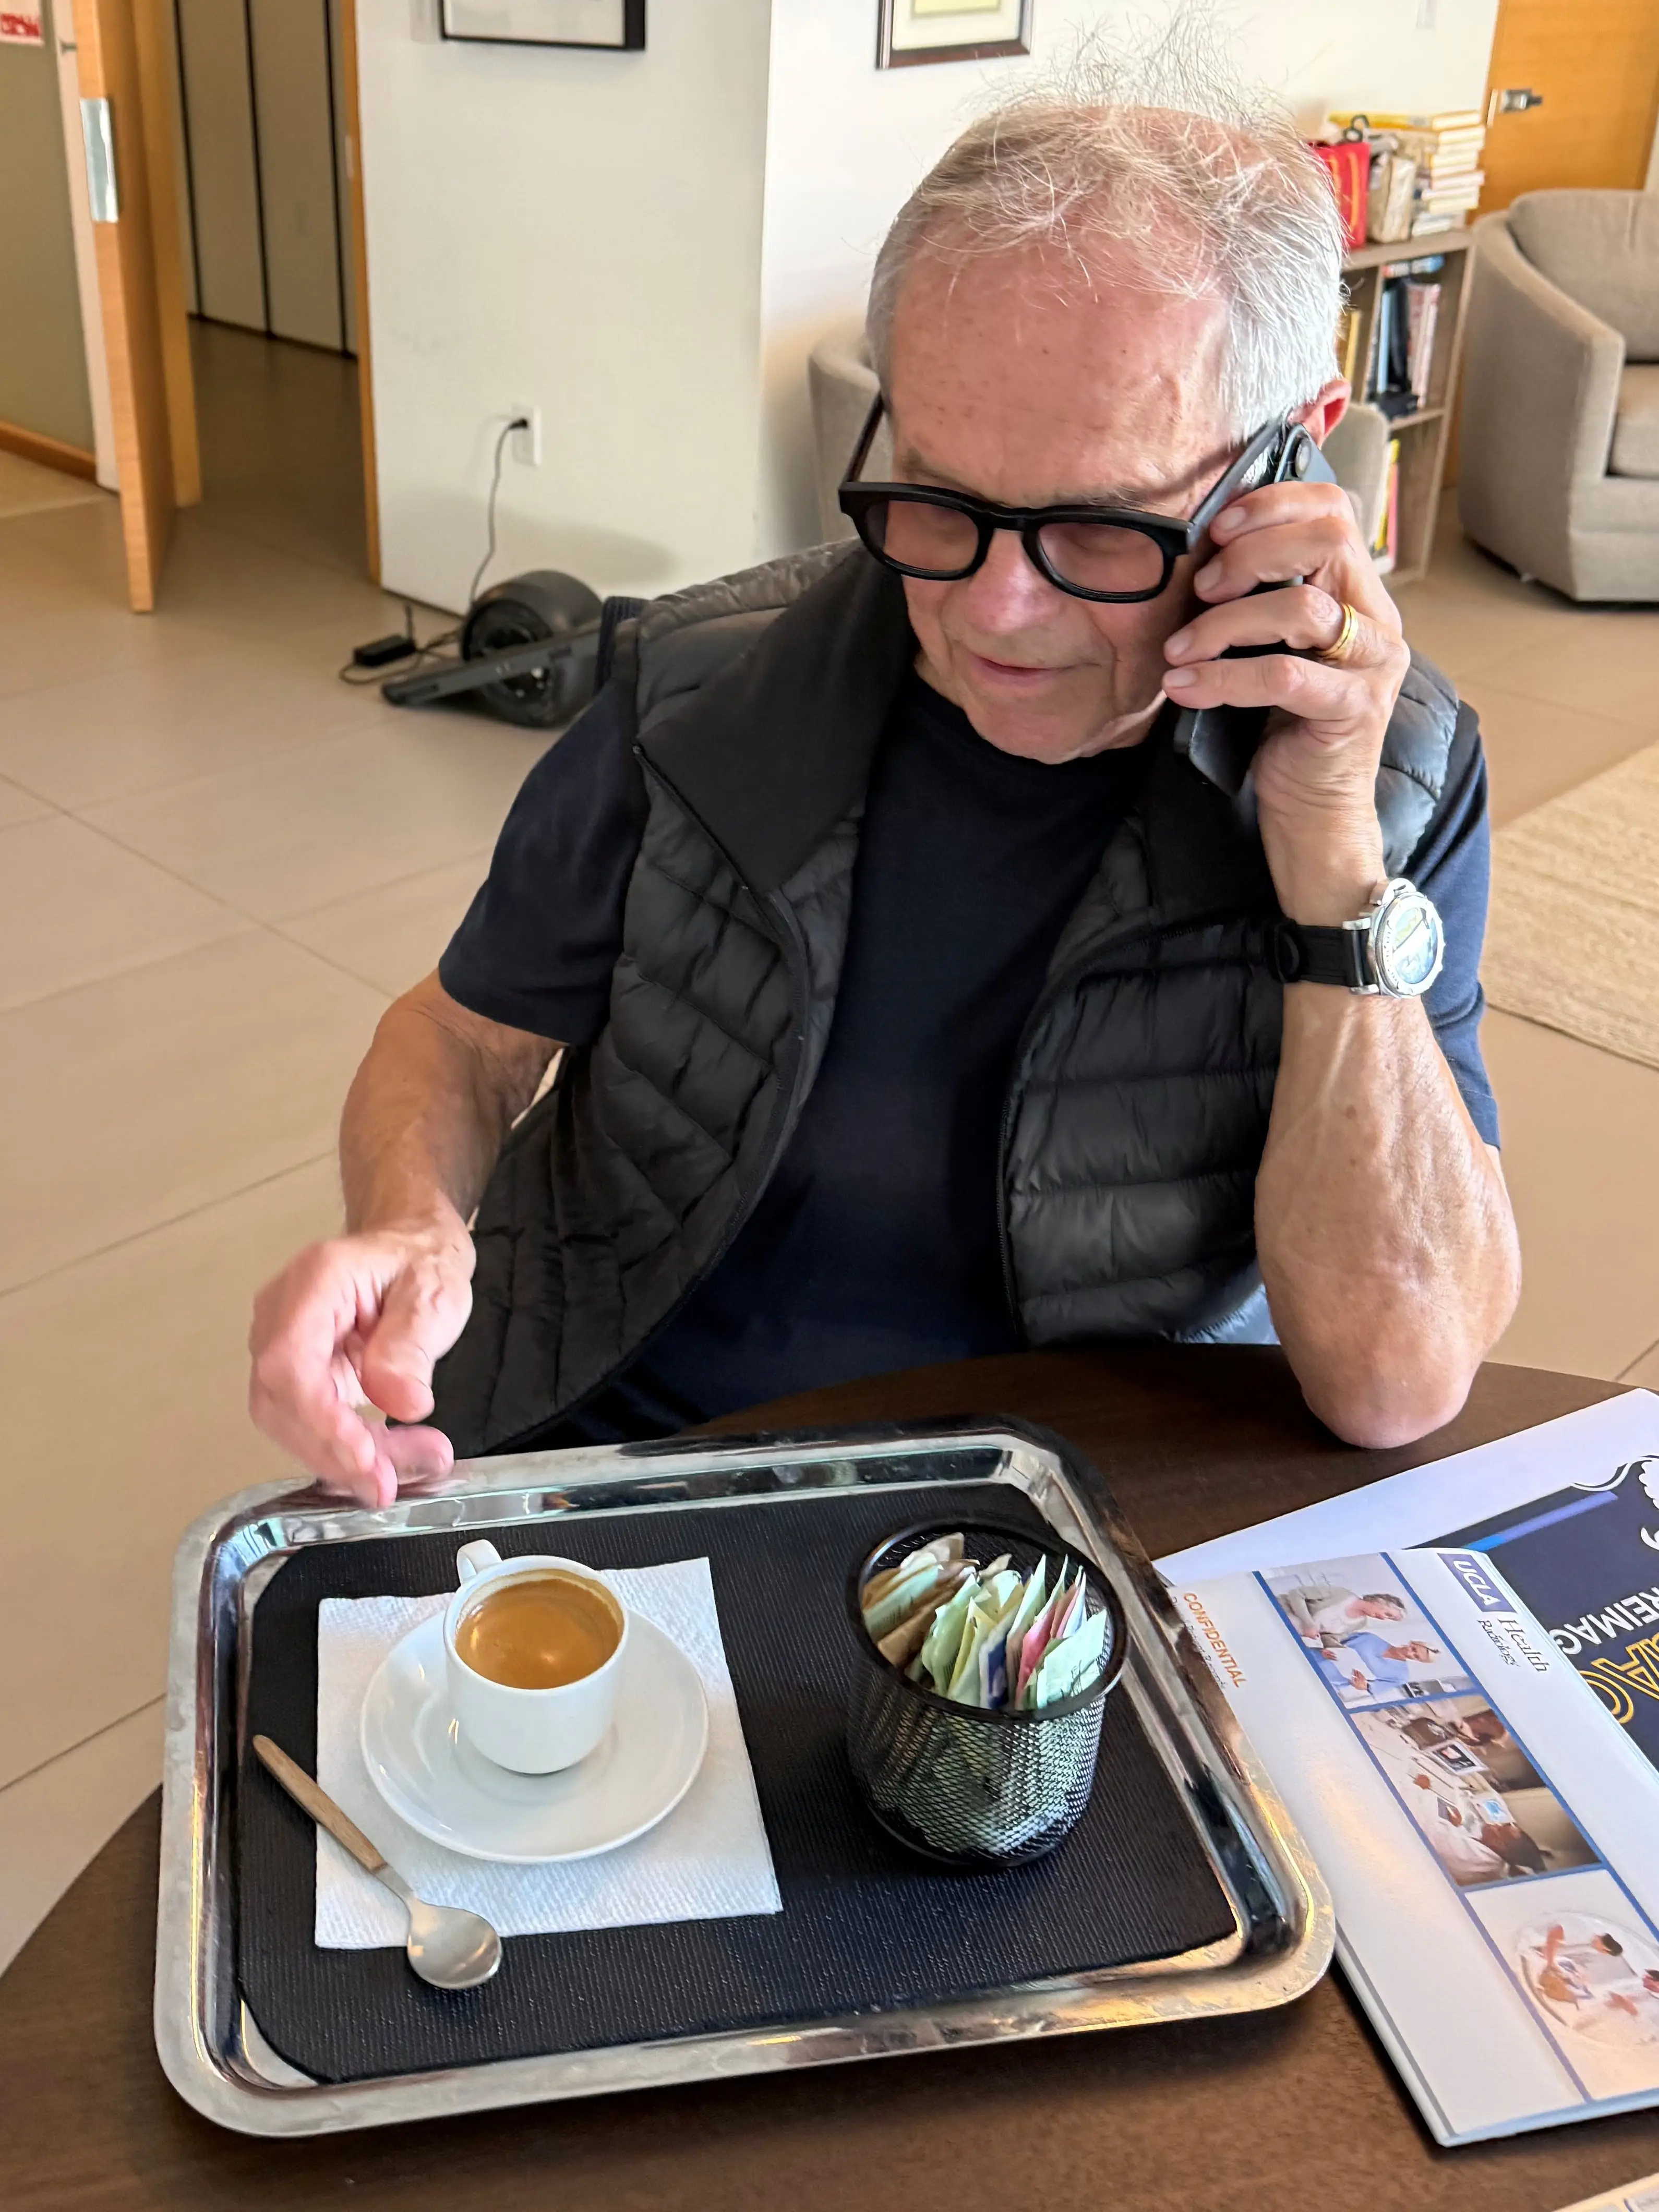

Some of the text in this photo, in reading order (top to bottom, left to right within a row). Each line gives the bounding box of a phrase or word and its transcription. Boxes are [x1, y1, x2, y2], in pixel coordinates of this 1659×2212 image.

[1183, 1593, 1247, 1688] CONFIDENTIAL
[1452, 1560, 1550, 1672] UCLA Health
